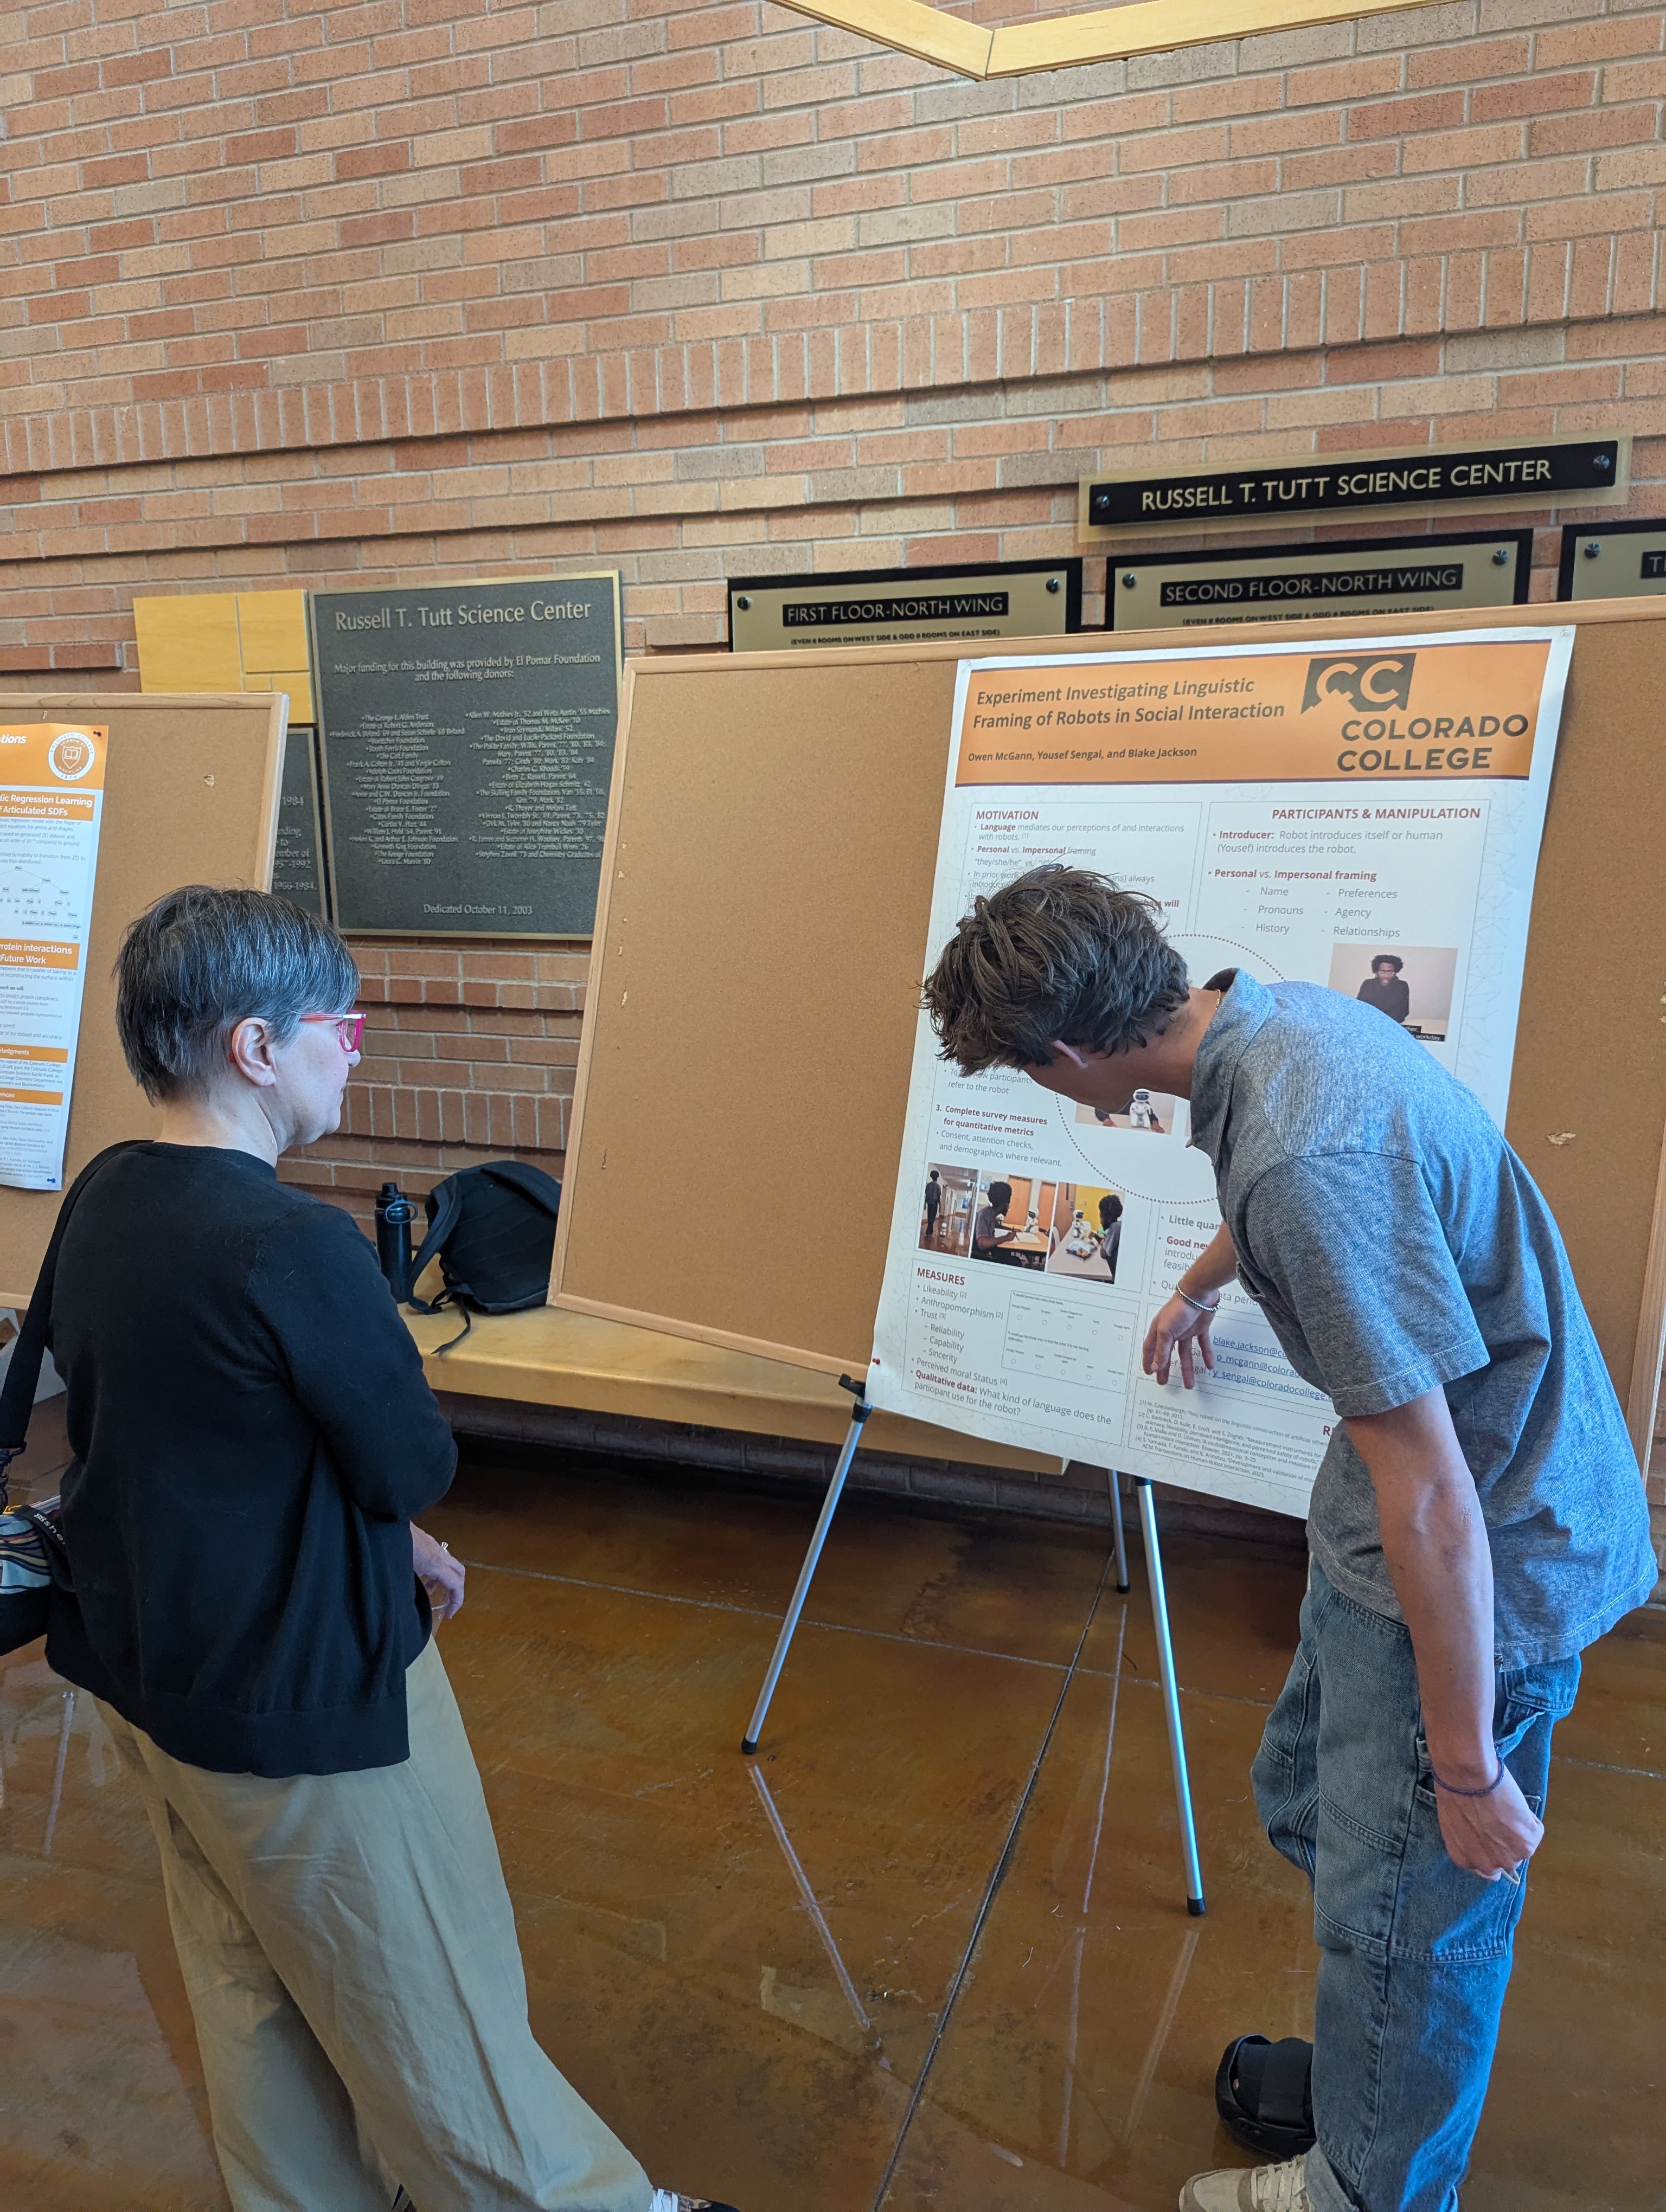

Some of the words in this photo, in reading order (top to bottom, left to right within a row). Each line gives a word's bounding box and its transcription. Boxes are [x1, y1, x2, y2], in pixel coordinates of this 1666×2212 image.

[1142, 485, 1232, 510] RUSSELL
[1239, 483, 1255, 502] T.
[1262, 477, 1330, 500] TUTT
[1337, 468, 1441, 495] SCIENCE
[1450, 460, 1551, 486] CENTER
[1166, 583, 1242, 601] SECOND
[1249, 574, 1392, 596] FLOOR-NORTH
[1398, 569, 1456, 587] WING
[336, 608, 390, 630] Russell
[395, 608, 412, 627] T.
[418, 607, 452, 626] Tutt
[458, 604, 524, 625] Science
[530, 601, 591, 620] Center
[788, 607, 826, 621] FIRST
[832, 600, 950, 620] FLOOR-NORTH
[954, 597, 1002, 612] WING
[334, 663, 356, 674] Major
[358, 662, 387, 673] funding
[388, 661, 399, 671] for
[400, 660, 414, 670] this
[416, 659, 448, 671] building
[466, 657, 502, 670] provided
[504, 656, 514, 668] by
[516, 655, 523, 665] El
[525, 655, 552, 665] Pomar
[554, 653, 600, 664] Foundation
[415, 671, 429, 681] and
[431, 671, 444, 680] the
[445, 670, 483, 681] following
[484, 670, 514, 678] donors:
[977, 688, 1062, 707] Experiment
[1066, 682, 1169, 701] Investigating
[1173, 678, 1254, 698] Linguistic
[973, 712, 1032, 730] Framing
[1036, 711, 1053, 725] of
[1056, 709, 1111, 725] Robots
[1115, 708, 1130, 723] in
[1135, 705, 1183, 722] Social
[1188, 702, 1284, 720] Interaction
[1341, 714, 1528, 741] COLORADO
[50, 733, 75, 753] COLORADO
[78, 734, 94, 754] COLLEGE
[968, 753, 992, 761] Owen
[995, 752, 1034, 761] McGann,
[1037, 750, 1069, 760] Yousef
[1070, 749, 1104, 761] Sengal,
[1107, 749, 1125, 758] and
[1128, 748, 1155, 758] Blake
[1156, 748, 1197, 759] Jackson
[1337, 747, 1492, 771] COLLEGE
[11, 794, 54, 803] Regression
[55, 796, 93, 807] Learning
[3, 806, 46, 814] Articulated
[47, 807, 67, 815] SDFs
[976, 811, 1039, 819] MOTIVATION
[1272, 809, 1359, 819] PARTICIPANTS
[1362, 808, 1371, 819] &
[1375, 808, 1481, 819] MANIPULATION
[981, 823, 1016, 832] Language
[1066, 824, 1110, 833] perceptions
[1219, 830, 1274, 839] Introducer:
[1279, 830, 1308, 839] Robot
[1310, 831, 1362, 839] introduces
[1364, 830, 1390, 839] itself
[1406, 831, 1442, 839] human
[1217, 843, 1253, 853] (Yousef)
[1256, 844, 1305, 853] introduces
[1309, 844, 1324, 853] the
[1327, 844, 1355, 853] robot.
[1214, 869, 1257, 877] Personal
[1274, 870, 1332, 880] Impersonal
[1335, 870, 1377, 882] framing
[1260, 887, 1289, 896] Name
[1338, 888, 1397, 898] Preferences
[424, 903, 462, 913] Dedicated
[464, 904, 496, 914] October
[498, 905, 510, 915] 11,
[512, 905, 533, 915] 2003
[1258, 905, 1303, 915] Pronouns
[1335, 908, 1371, 919] Agency
[1256, 923, 1289, 935] History
[1333, 926, 1400, 939] Relationships
[23, 943, 72, 954] interactions
[0, 954, 24, 962] Future
[25, 955, 46, 963] Work
[945, 1105, 980, 1116] Complete
[982, 1111, 1008, 1121] survey
[1009, 1115, 1047, 1124] measures
[956, 1121, 1002, 1132] quantitative
[1004, 1127, 1034, 1136] metrics
[917, 1267, 965, 1285] MEASURES
[922, 1284, 958, 1300] Likeability
[920, 1308, 937, 1320] Trust
[931, 1323, 964, 1340] Reliability
[930, 1335, 964, 1353] Capability
[928, 1348, 957, 1364] Sincerity
[915, 1369, 955, 1387] Qualitative
[957, 1381, 977, 1393] data:
[979, 1387, 1000, 1399] What
[1002, 1392, 1020, 1403] kind
[1022, 1398, 1031, 1406] of
[1033, 1399, 1071, 1416] language
[1073, 1409, 1094, 1420] does
[1097, 1414, 1111, 1424] the
[1154, 1445, 1183, 1457] Transactions
[1190, 1455, 1223, 1467] Human-Robot
[1224, 1463, 1251, 1474] Interaction,
[1252, 1469, 1265, 1477] 2025.
